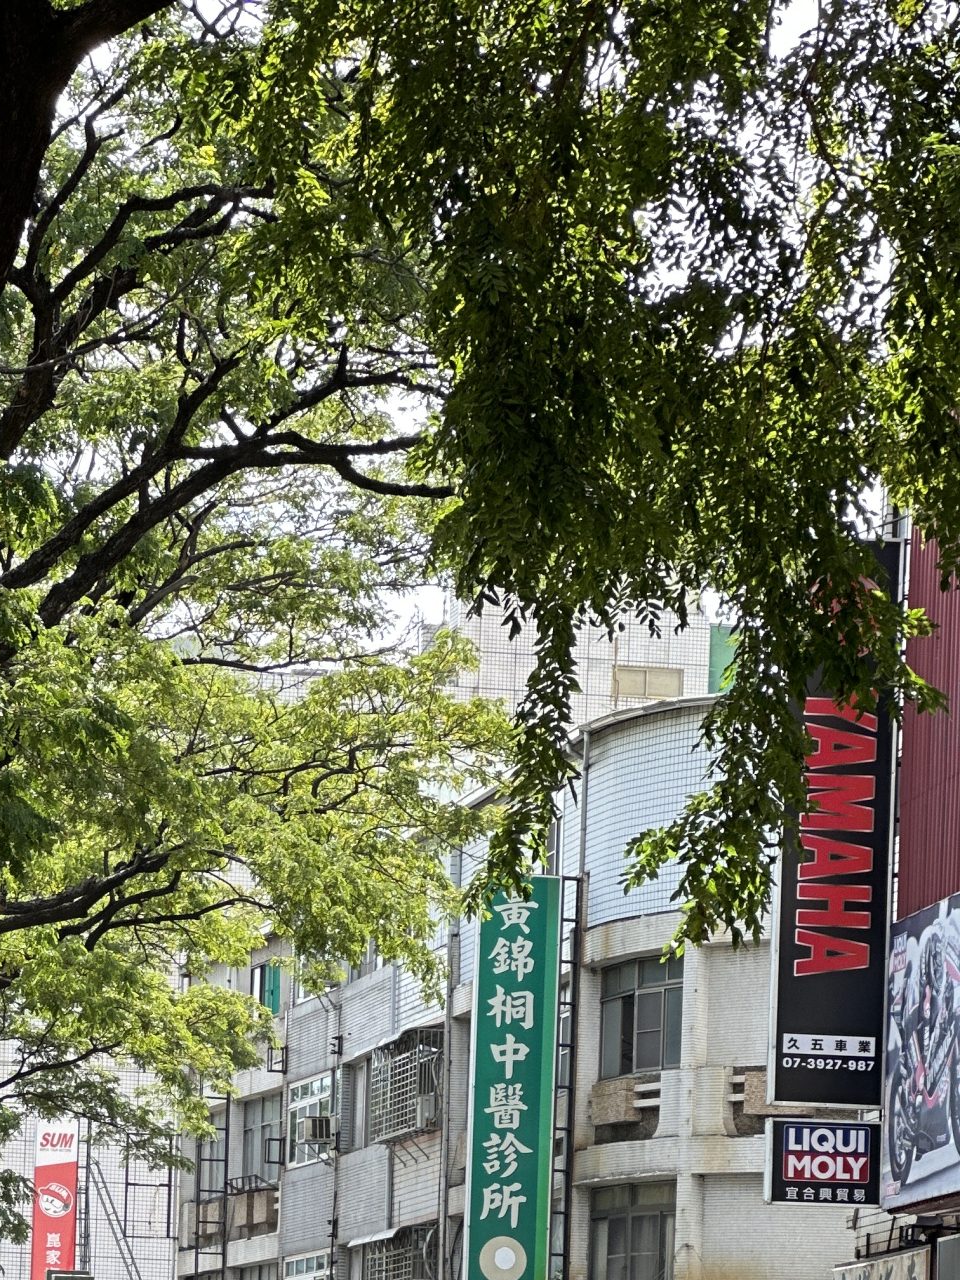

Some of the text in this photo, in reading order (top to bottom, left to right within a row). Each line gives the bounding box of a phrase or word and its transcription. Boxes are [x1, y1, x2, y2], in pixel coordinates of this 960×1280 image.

[794, 690, 878, 976] YAMAHA
[787, 1038, 871, 1053] 久五車業
[480, 891, 538, 1229] 黃錦桐中醫診所
[783, 1057, 874, 1072] 07-3927-987
[40, 1132, 74, 1149] SUM
[788, 1127, 865, 1153] LIQUI
[788, 1155, 867, 1180] MOLY
[786, 1187, 866, 1202] 宜合興貿易
[46, 1232, 61, 1272] 崑家
